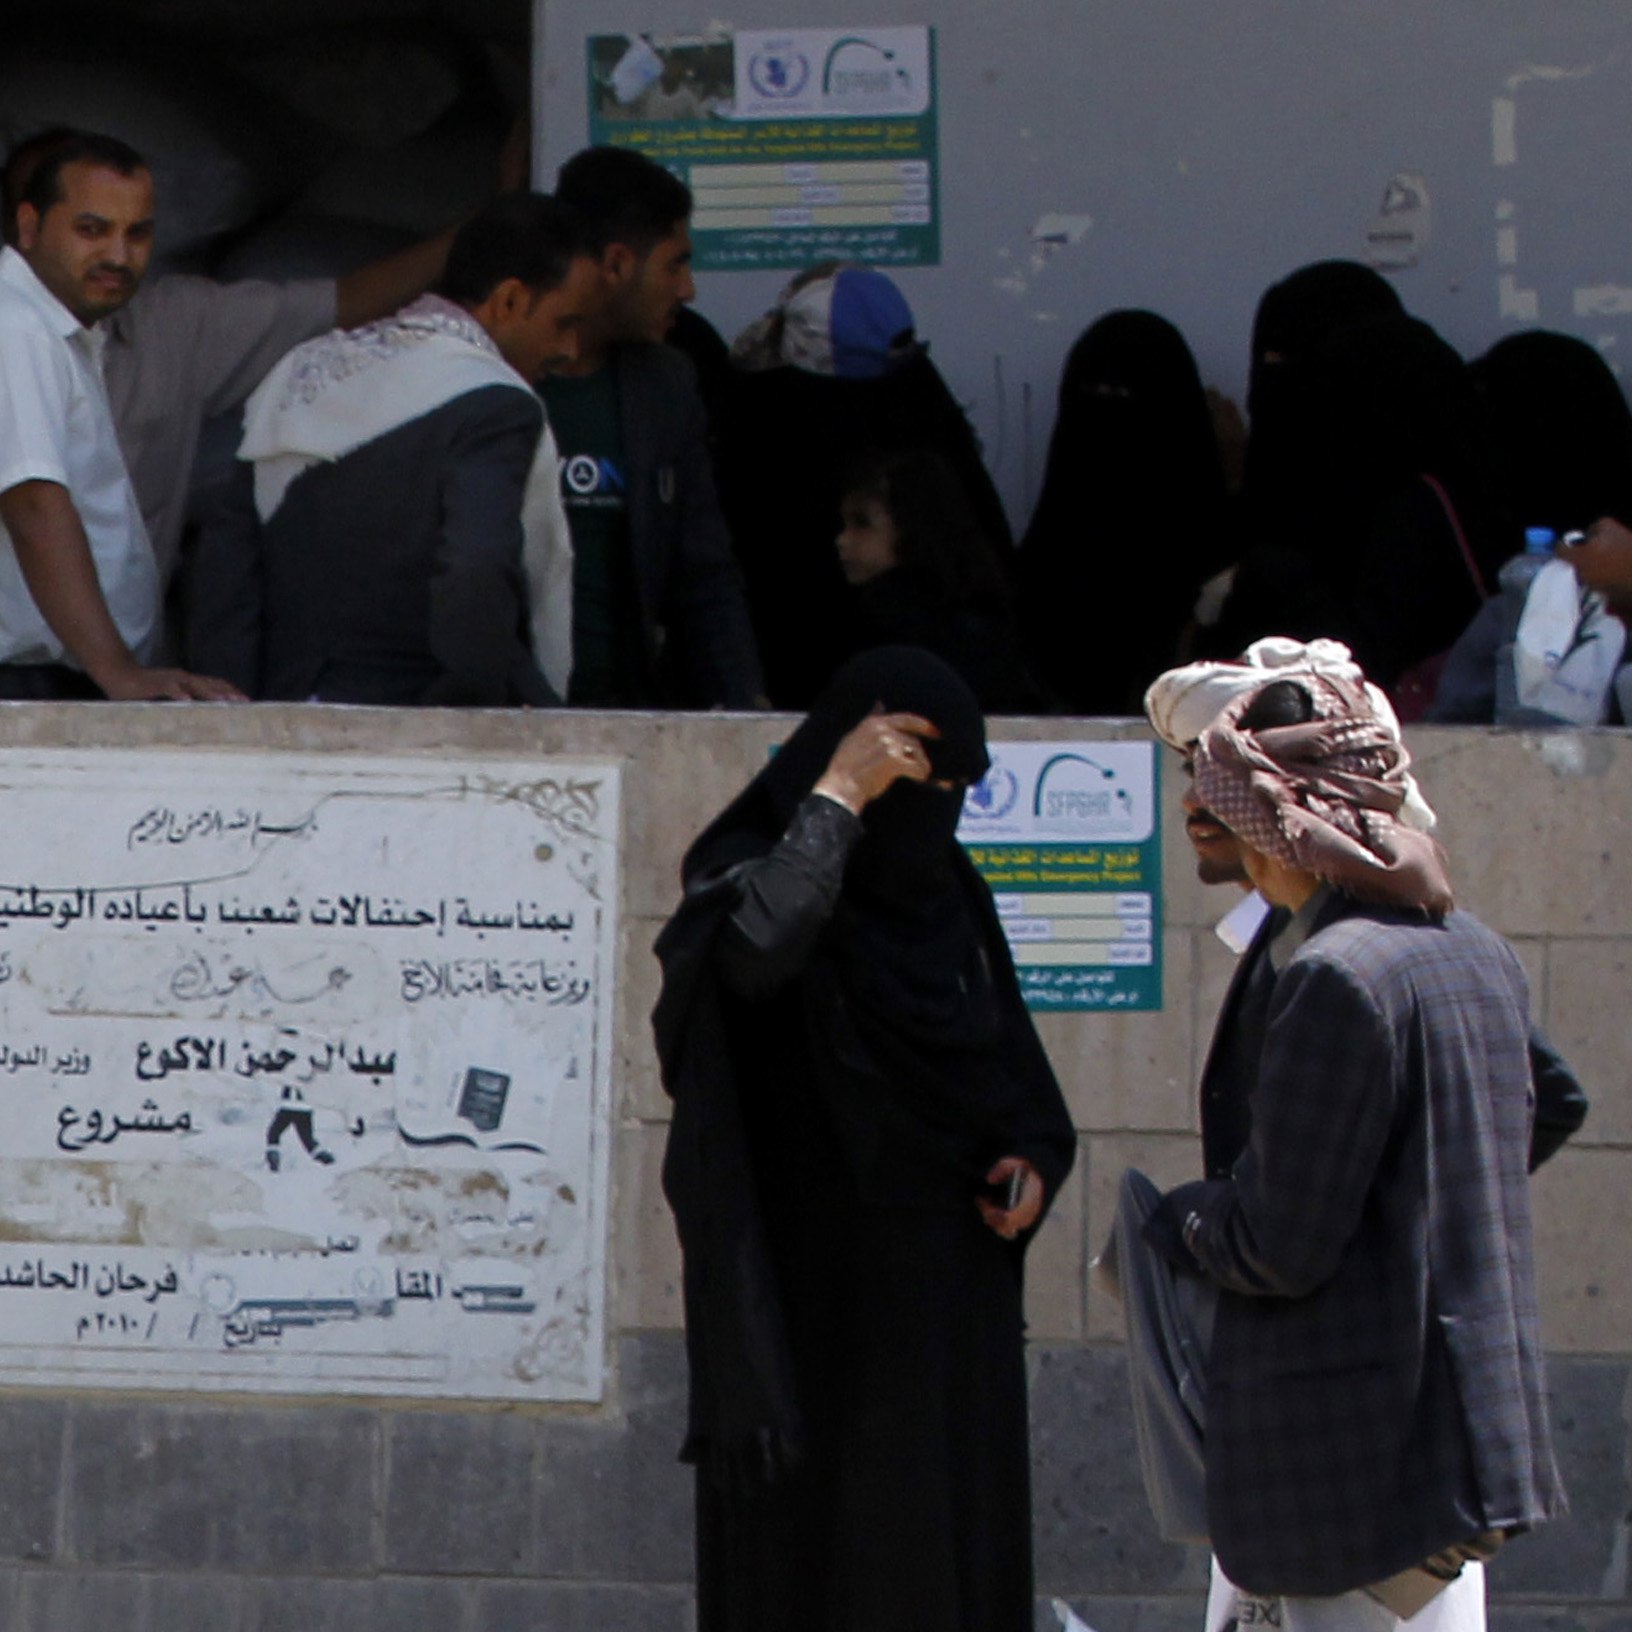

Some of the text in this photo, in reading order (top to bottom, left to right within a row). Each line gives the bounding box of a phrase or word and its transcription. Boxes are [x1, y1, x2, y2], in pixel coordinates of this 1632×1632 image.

[219, 896, 302, 936] شعبنا
[457, 897, 573, 943] بمناسبة
[56, 1098, 193, 1151] مشروع
[94, 1264, 179, 1302] فرحان
